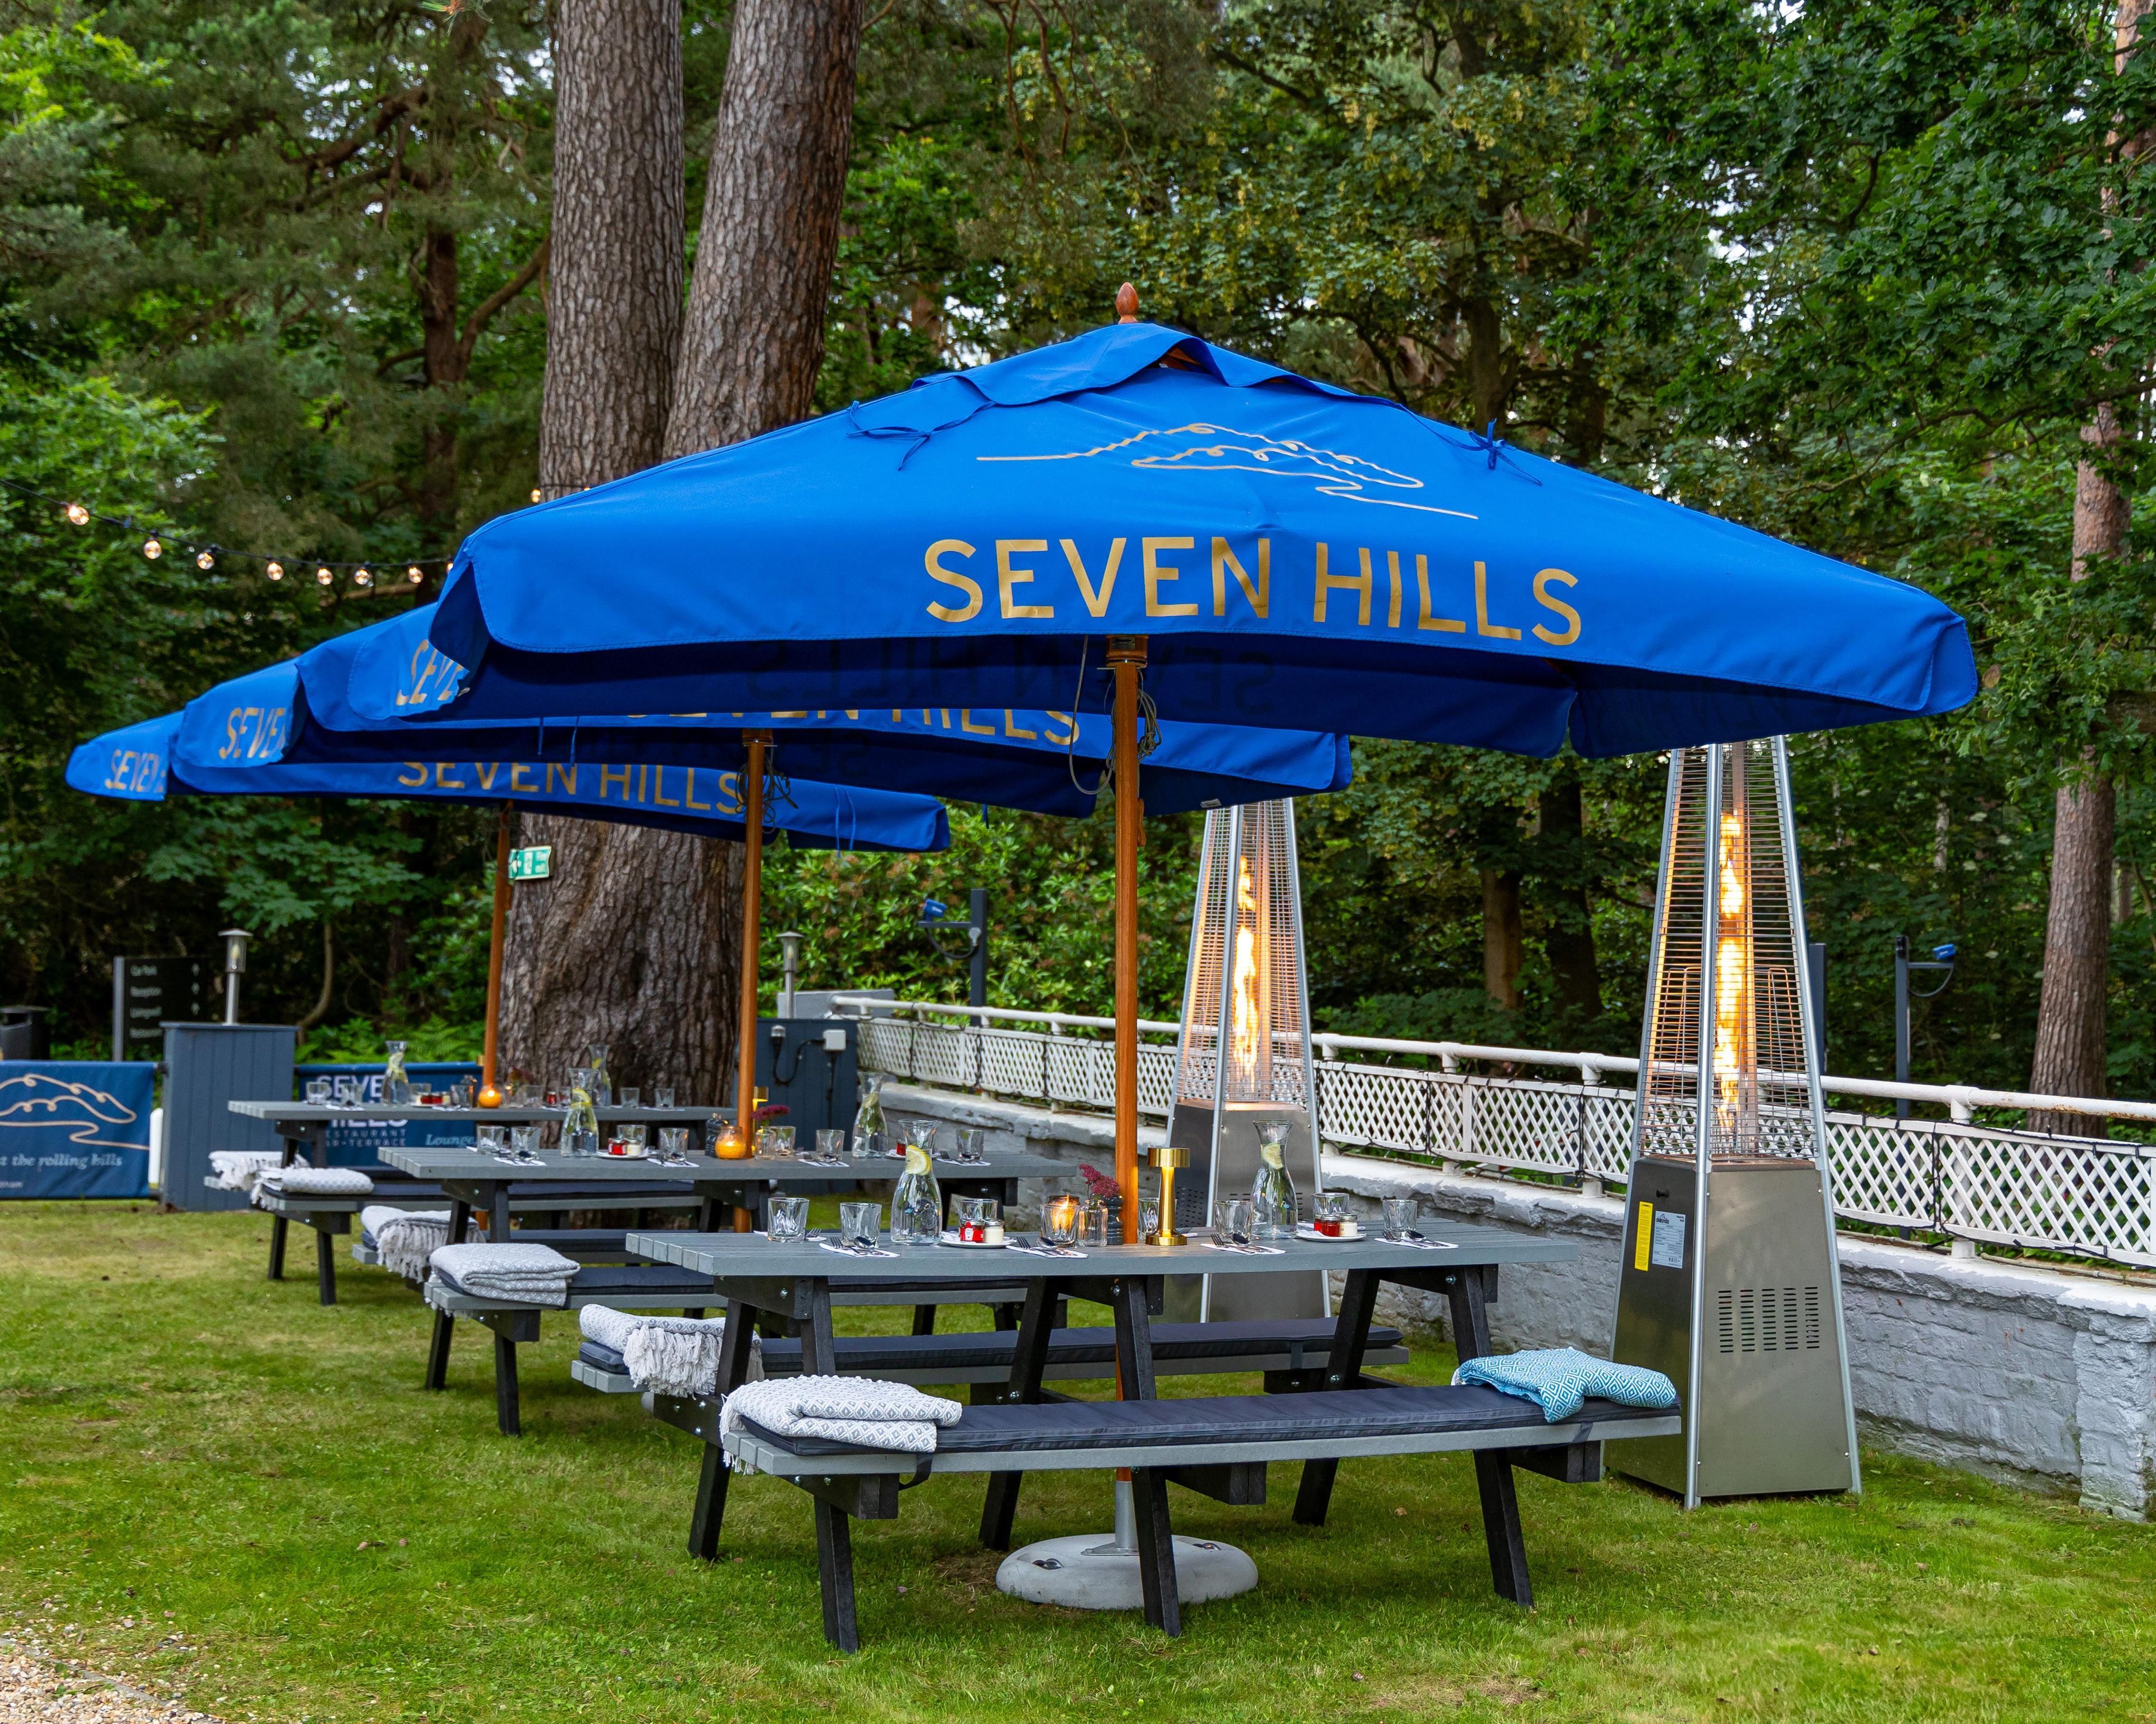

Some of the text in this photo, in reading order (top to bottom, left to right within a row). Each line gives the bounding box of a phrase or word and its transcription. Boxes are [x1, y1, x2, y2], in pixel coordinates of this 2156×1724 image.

[925, 536, 1581, 646] SEVEN HILLS
[12, 1153, 35, 1167] the
[37, 1153, 89, 1170] rolling
[90, 1153, 123, 1167] hills
